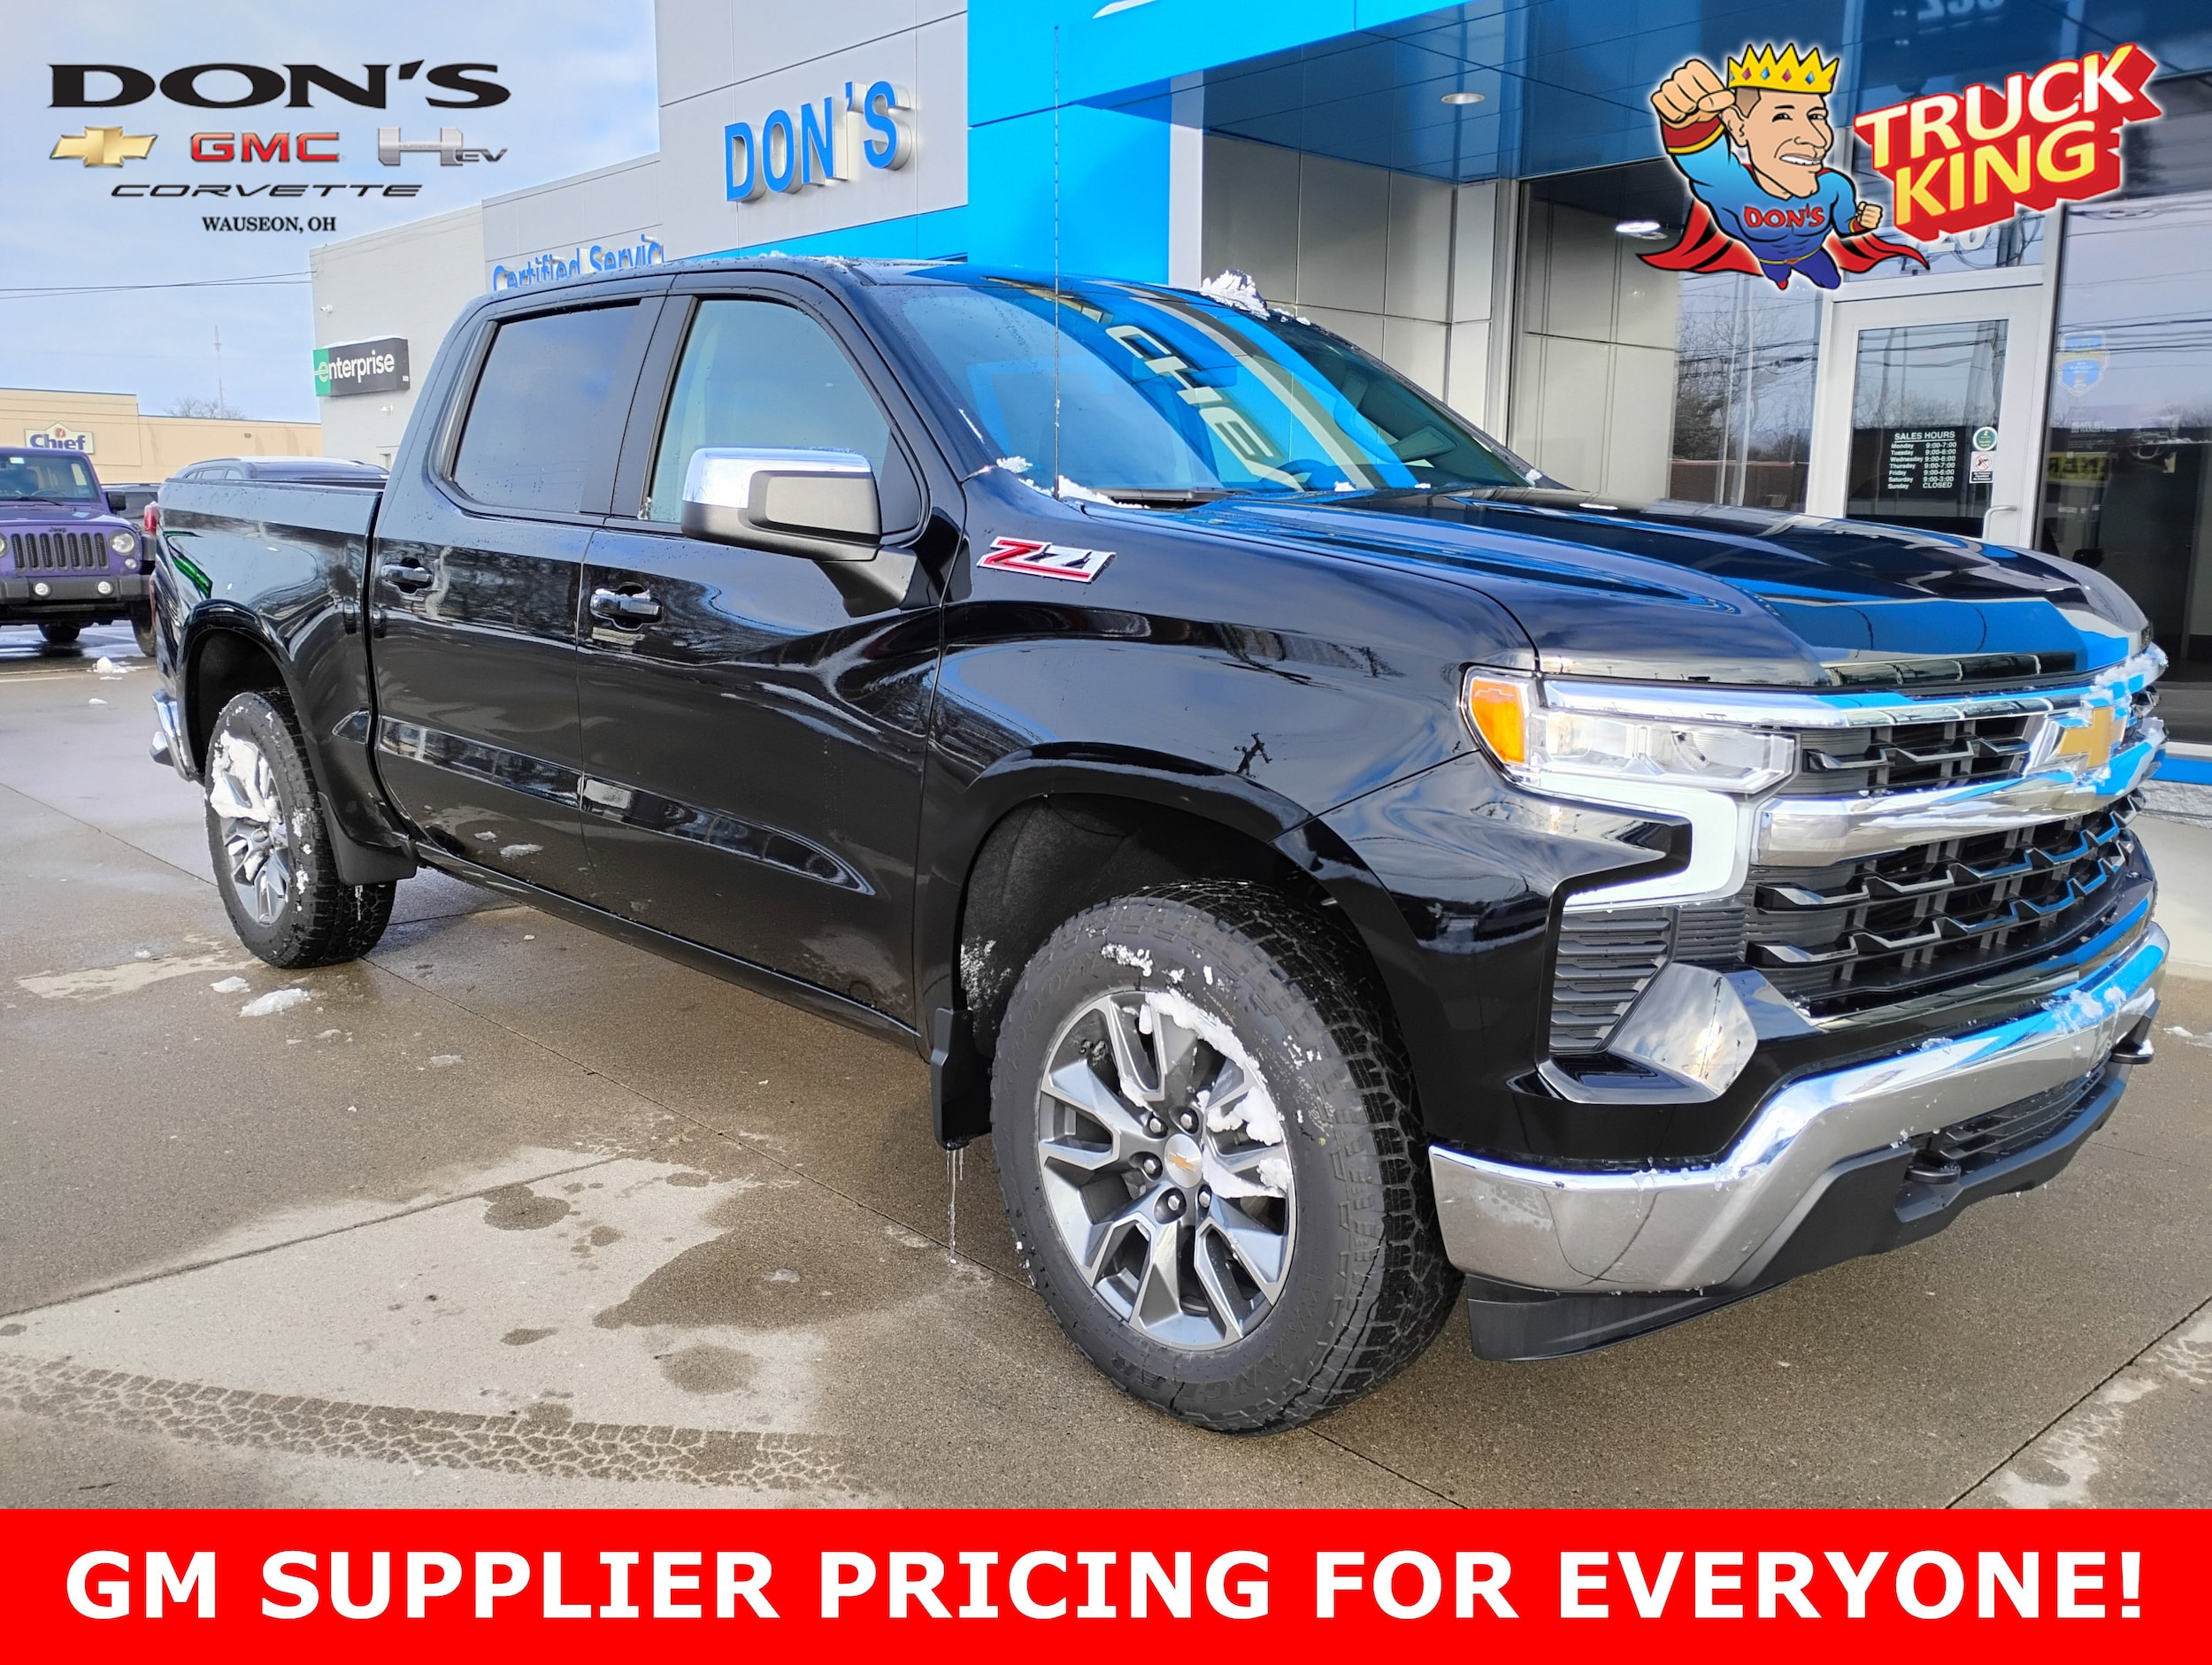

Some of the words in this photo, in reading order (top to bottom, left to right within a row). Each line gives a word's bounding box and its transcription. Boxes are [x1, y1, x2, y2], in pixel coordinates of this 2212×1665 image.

[724, 81, 897, 202] DON'S
[493, 248, 580, 290] Certified
[590, 234, 664, 272] Servic
[318, 349, 395, 383] enterprise
[30, 434, 86, 450] Chief
[976, 536, 1117, 583] Z71
